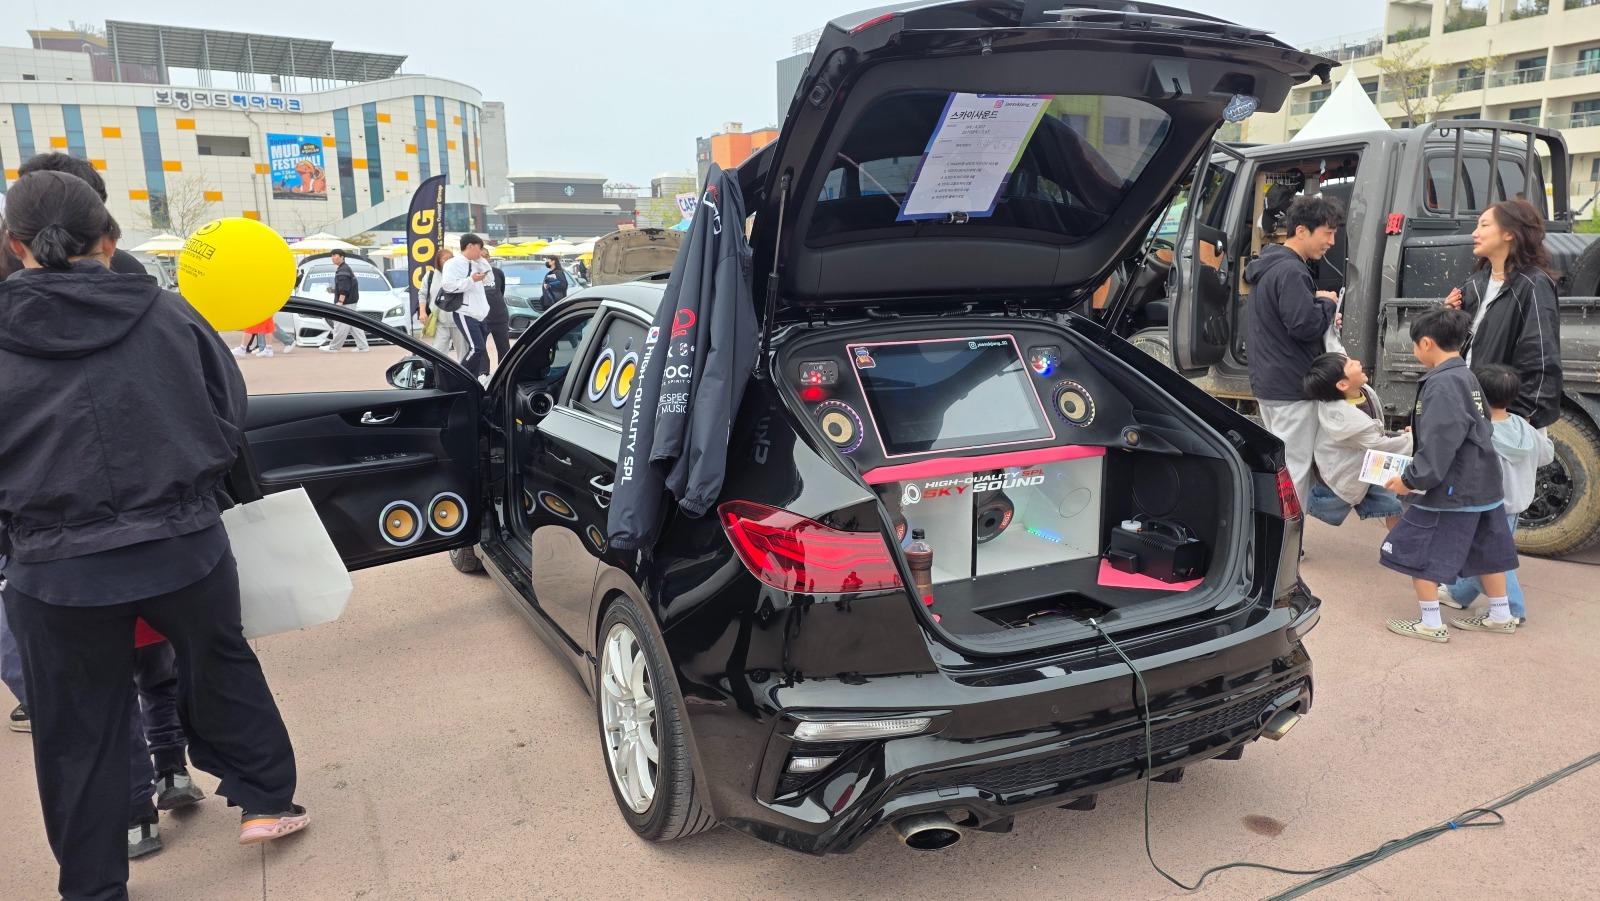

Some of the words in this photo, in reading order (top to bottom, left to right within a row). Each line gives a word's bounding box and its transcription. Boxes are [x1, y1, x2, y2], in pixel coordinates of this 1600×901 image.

[949, 110, 999, 120] 스카이사운드
[271, 144, 300, 160] MUD
[411, 208, 435, 290] COG
[663, 364, 693, 379] OC
[626, 345, 655, 453] HIGH-QUALITY
[659, 392, 690, 402] ESPEC
[620, 456, 634, 486] SPL
[924, 471, 1020, 489] HIGH-QUALITY
[1021, 469, 1045, 477] SPL
[922, 485, 969, 499] SKY
[973, 475, 1045, 493] SOUND
